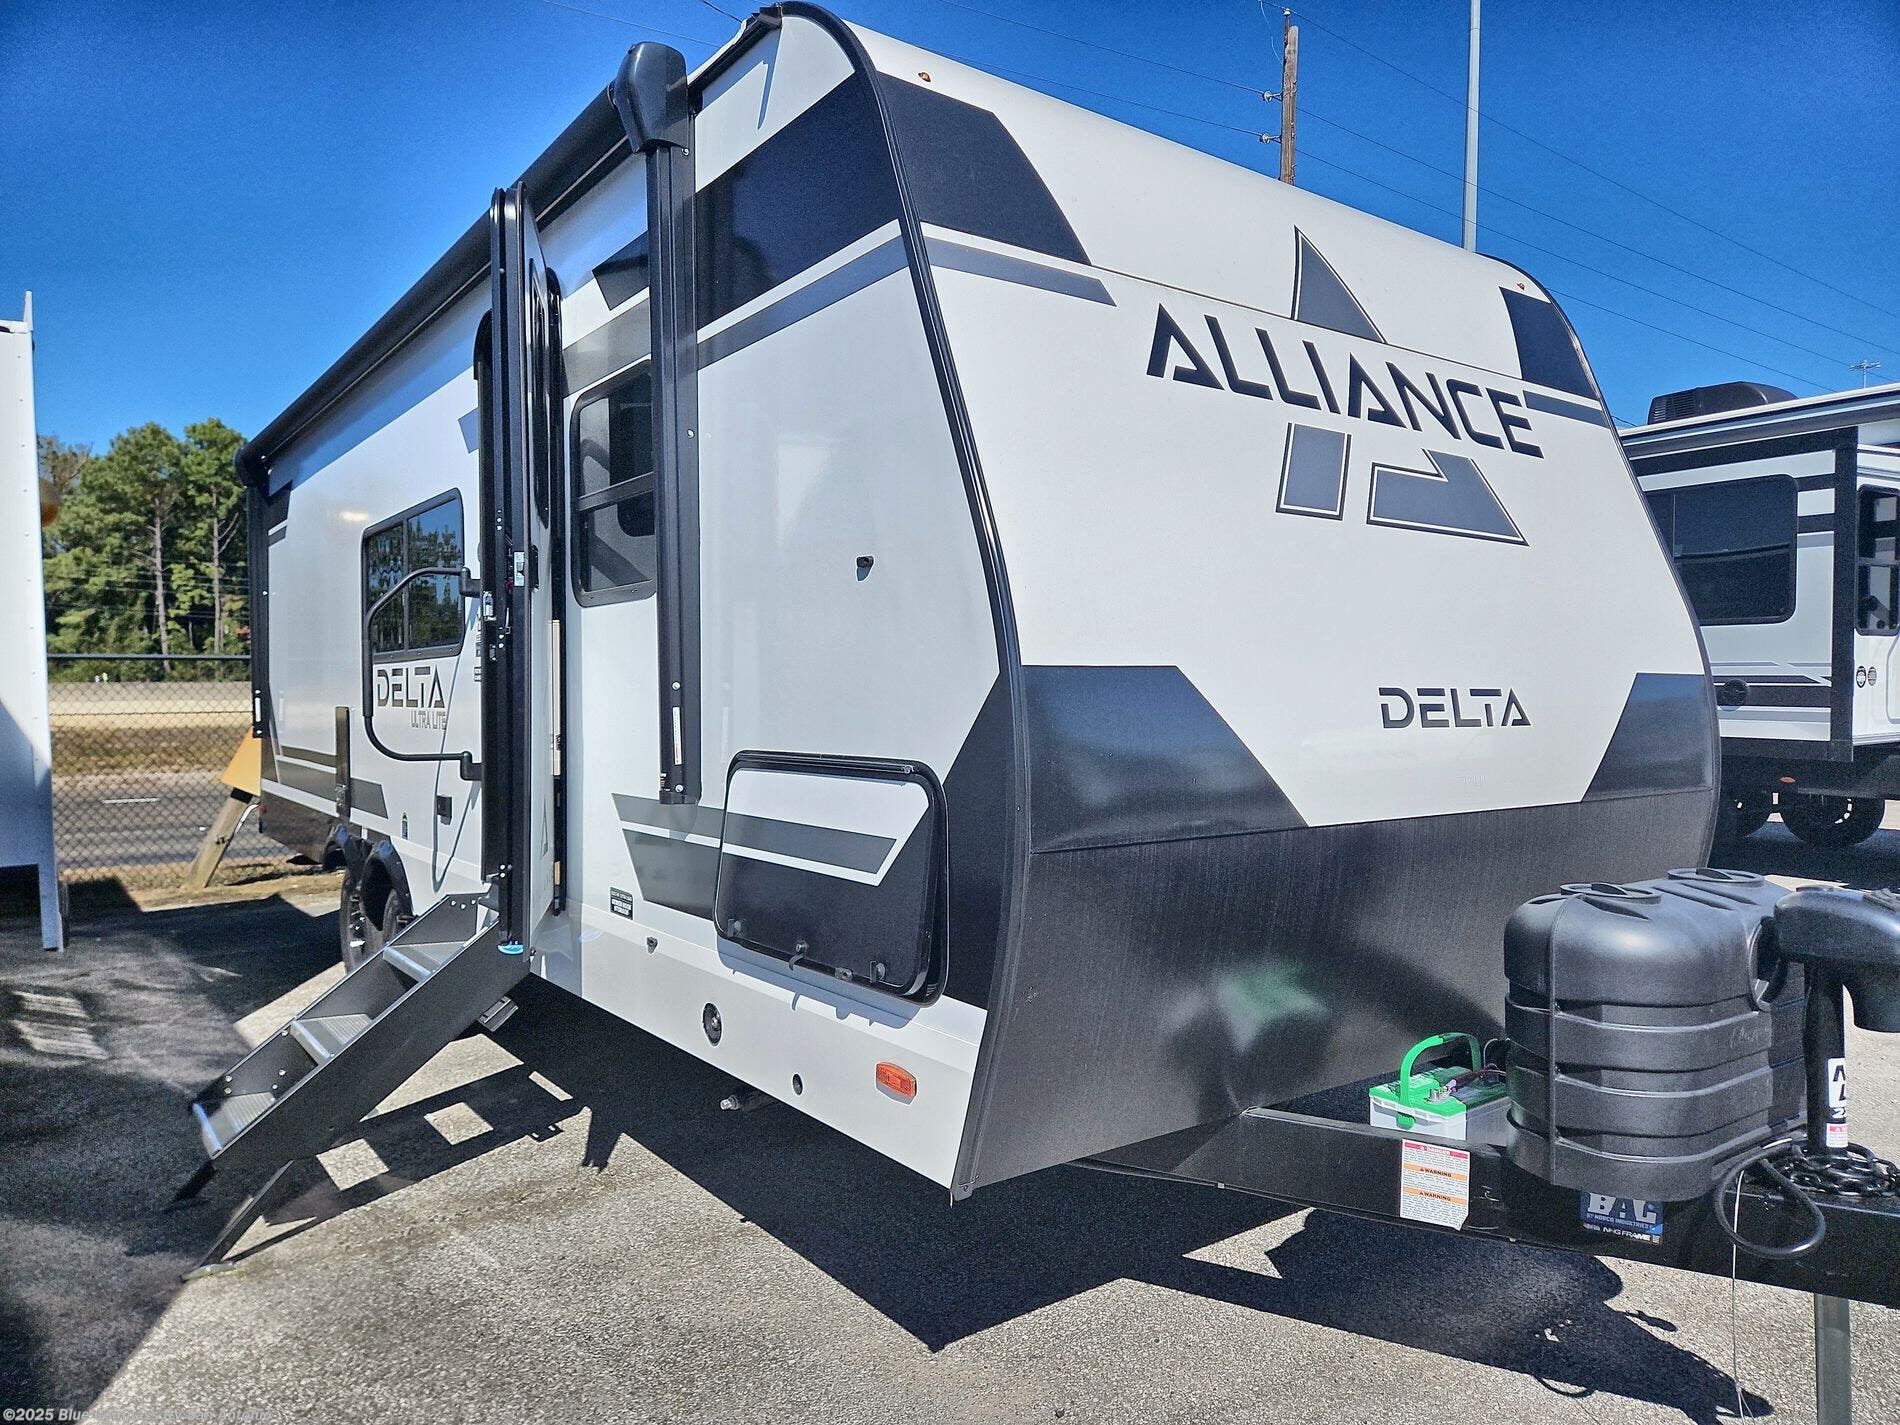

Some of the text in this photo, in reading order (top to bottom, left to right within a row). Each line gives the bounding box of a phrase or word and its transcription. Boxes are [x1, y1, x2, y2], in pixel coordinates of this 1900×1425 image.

[1146, 302, 1544, 458] ALLIANCE
[378, 664, 445, 708] DELTA
[1378, 687, 1531, 728] DELTA
[410, 710, 431, 729] ULTRA
[1424, 1168, 1452, 1177] WARNING
[1424, 1192, 1451, 1201] WARNING
[1622, 1230, 1651, 1241] FRAME
